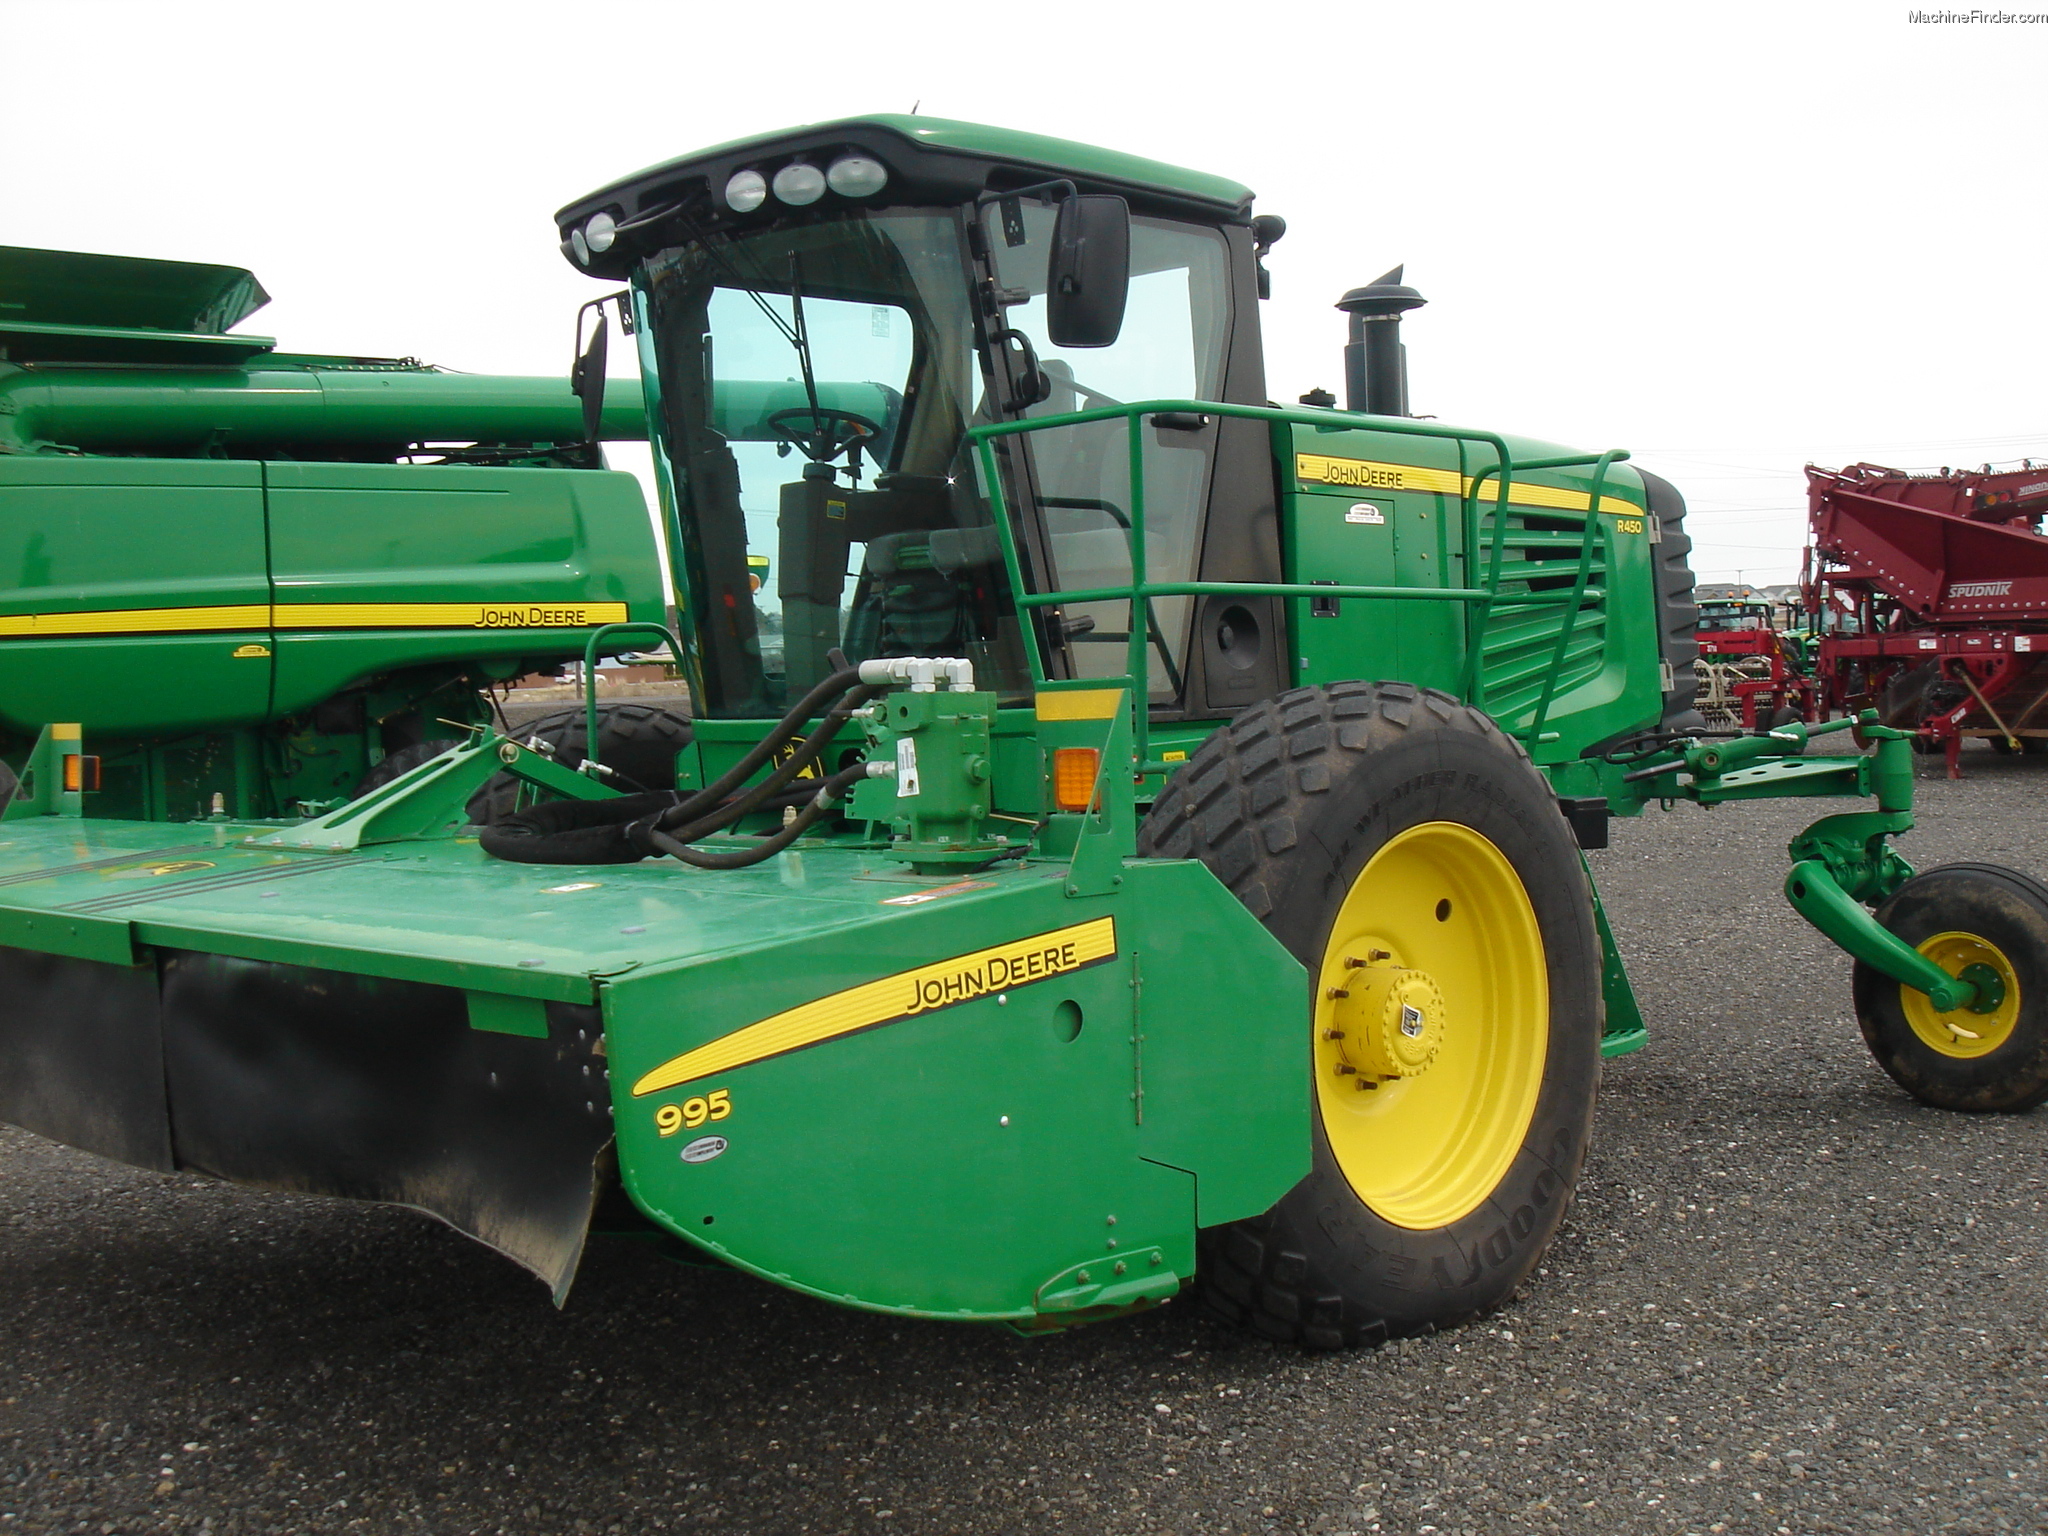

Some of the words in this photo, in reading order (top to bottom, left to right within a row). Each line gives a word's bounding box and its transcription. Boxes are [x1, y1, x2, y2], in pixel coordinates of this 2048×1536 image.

[1322, 461, 1359, 483] JOHN
[1360, 465, 1403, 488] DEERE
[2018, 481, 2048, 496] UDNIK
[1616, 518, 1643, 535] R450
[1948, 582, 2013, 598] SPUDNIK
[475, 607, 525, 626] JOHN
[529, 607, 588, 625] DEERE
[907, 965, 984, 1013] JOHN
[986, 941, 1078, 990] DEERE
[655, 1087, 732, 1137] 995
[1315, 1126, 1572, 1293] GOODYEAR
